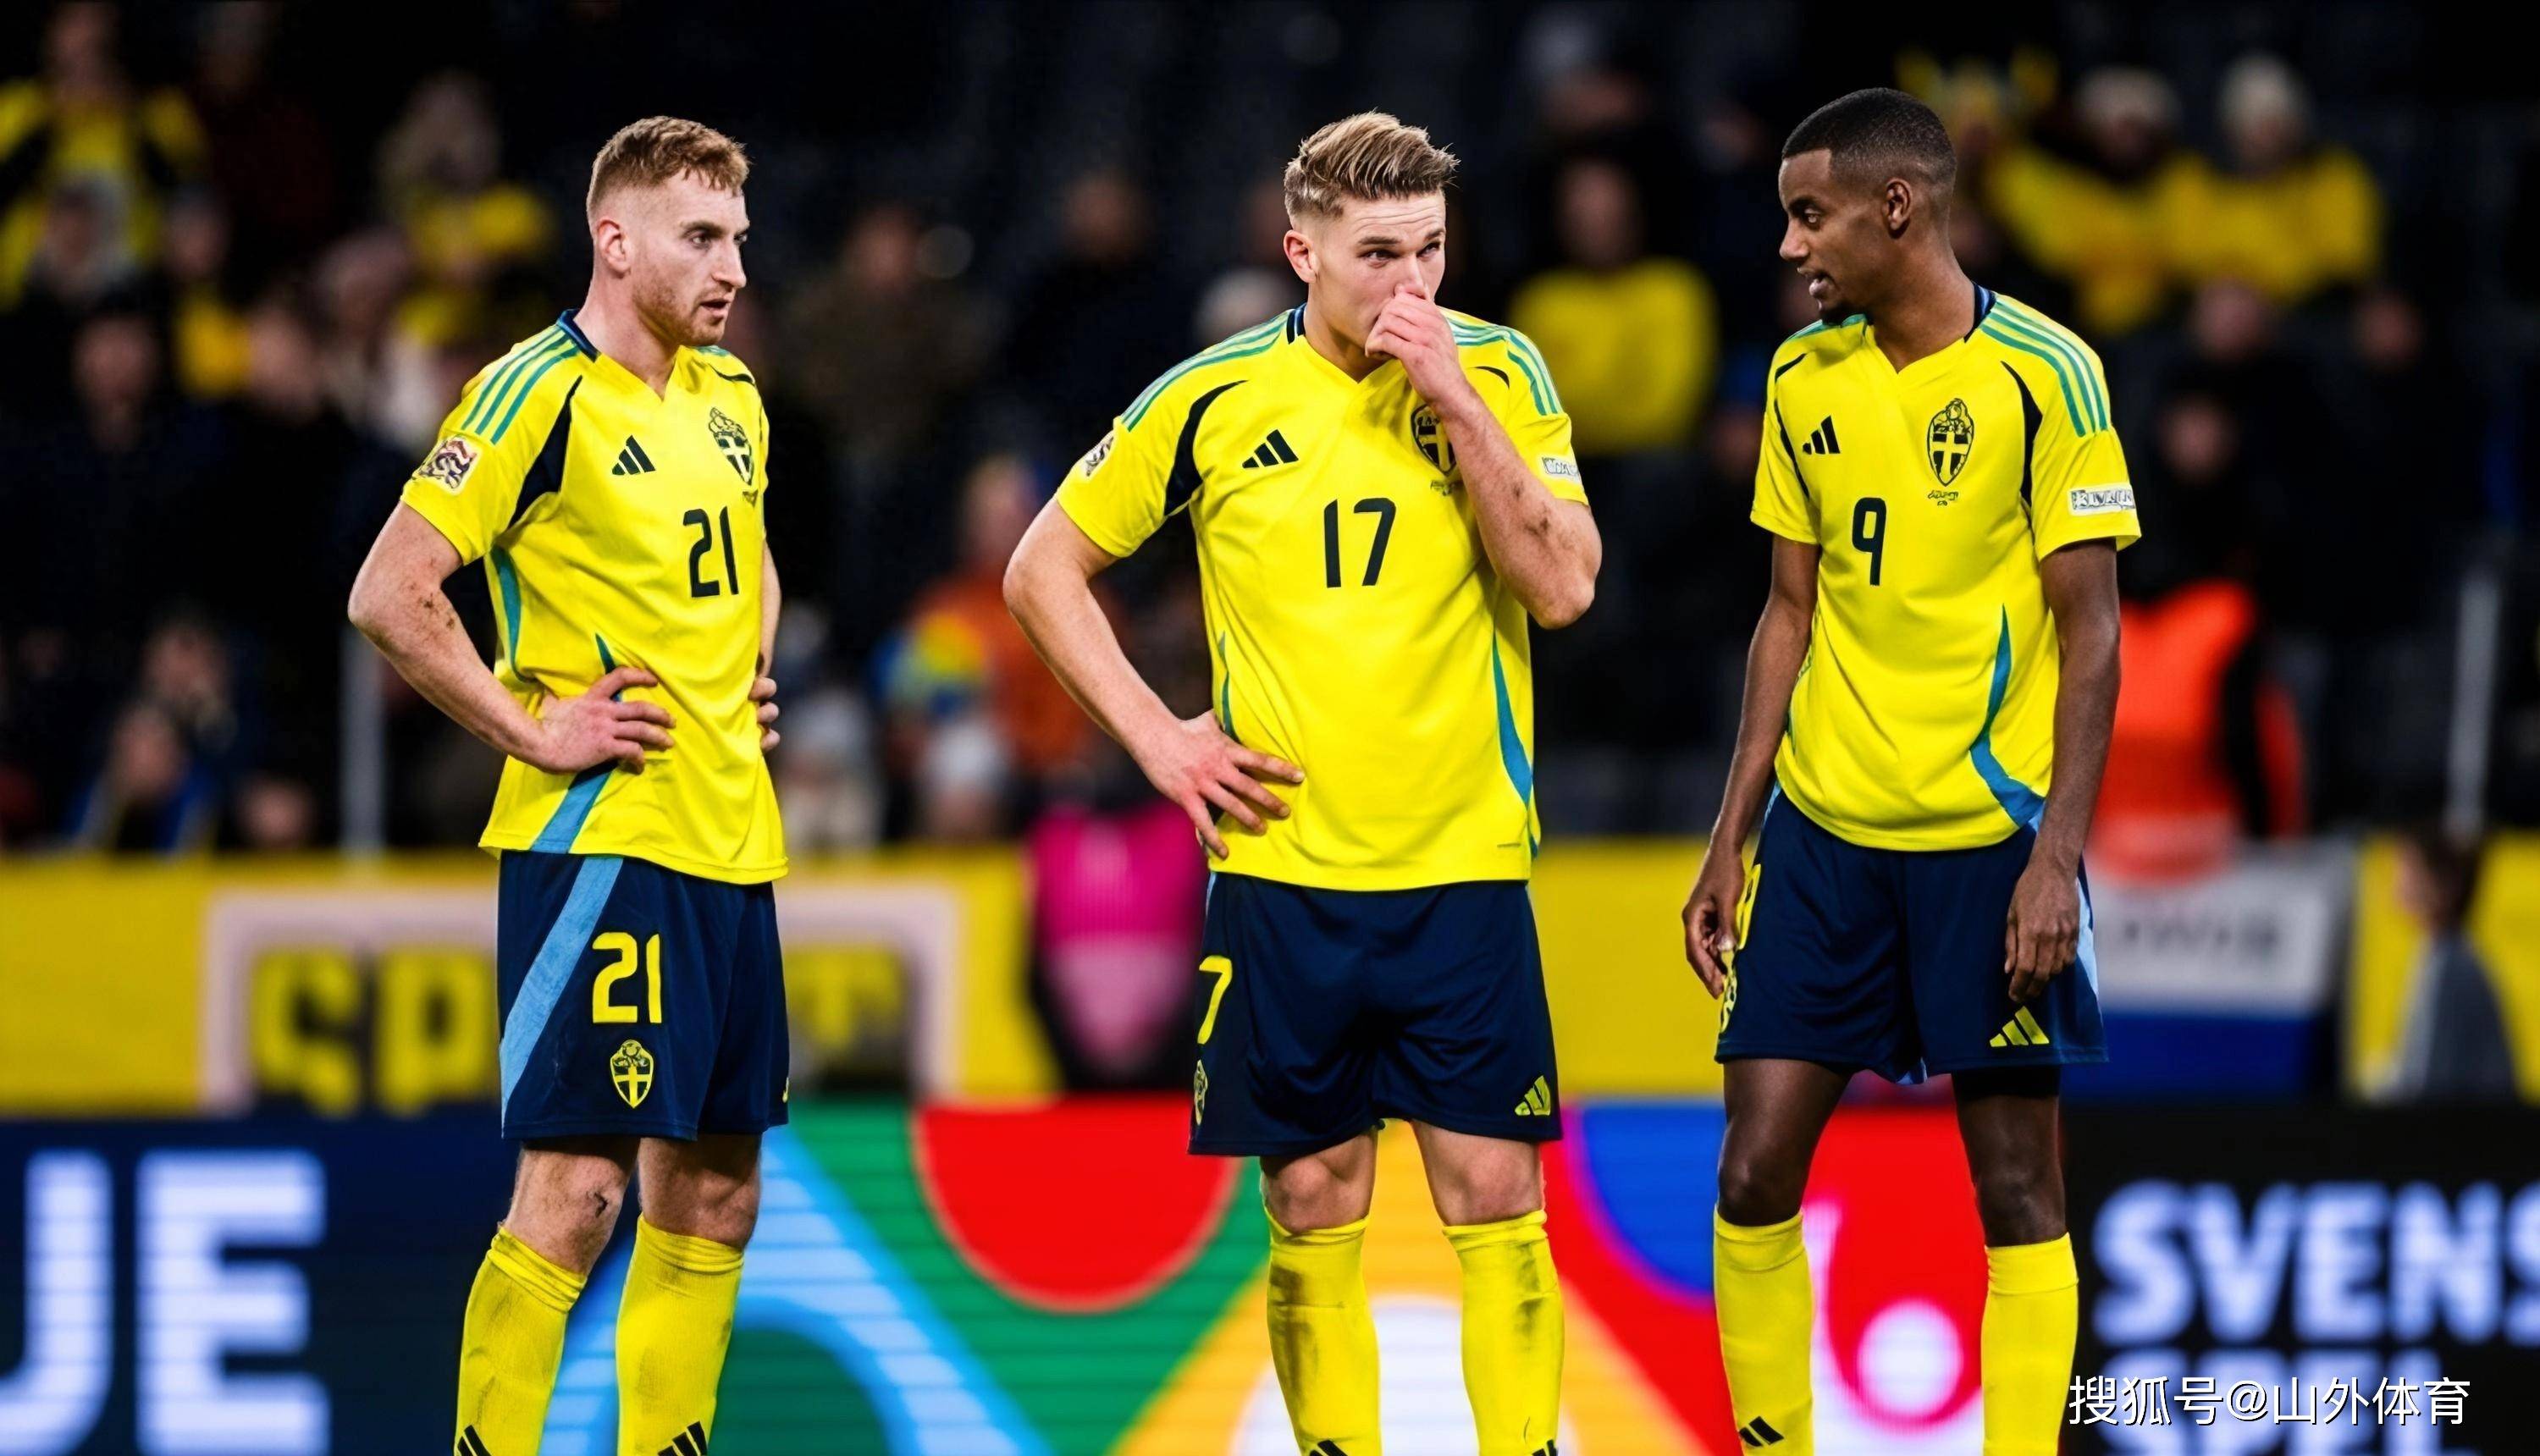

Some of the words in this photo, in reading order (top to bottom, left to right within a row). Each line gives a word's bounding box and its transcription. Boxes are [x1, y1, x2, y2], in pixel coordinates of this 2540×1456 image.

[682, 505, 740, 598] 21
[1323, 497, 1397, 589] 17
[1852, 497, 1887, 587] 9
[592, 931, 663, 1024] 21
